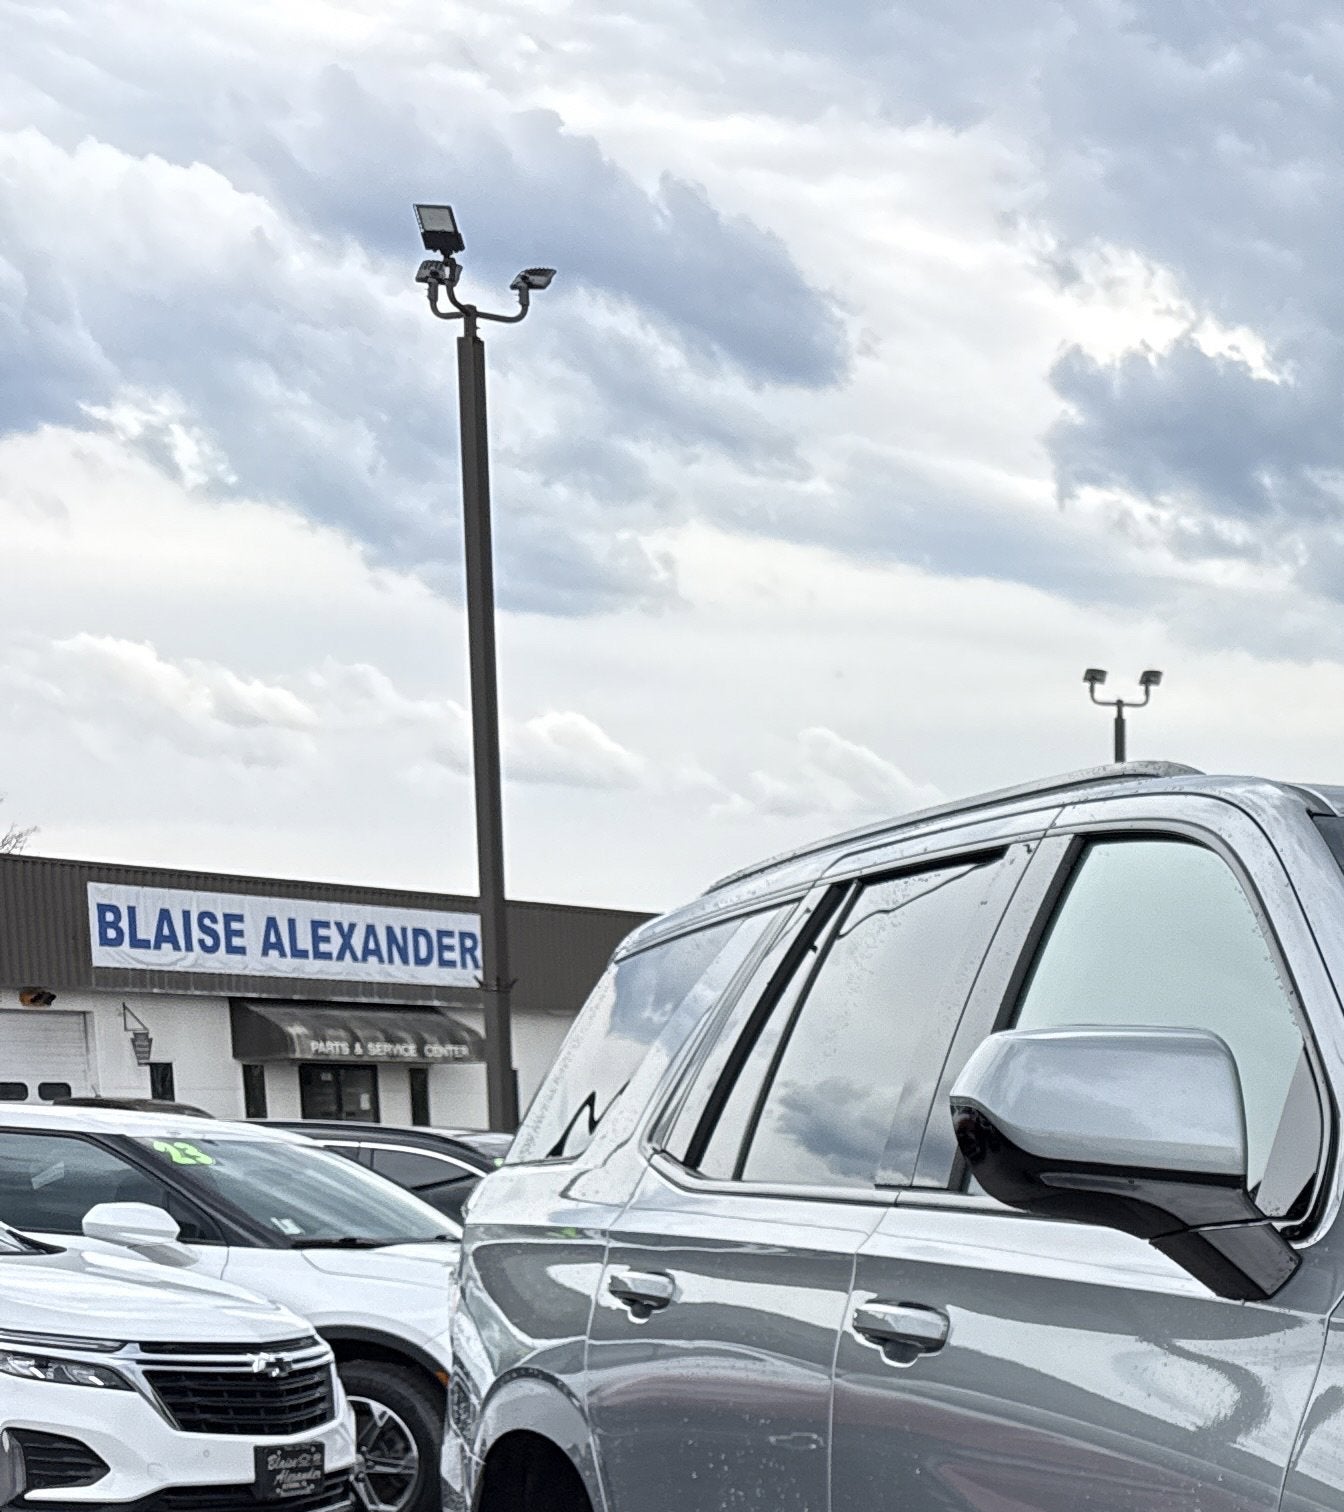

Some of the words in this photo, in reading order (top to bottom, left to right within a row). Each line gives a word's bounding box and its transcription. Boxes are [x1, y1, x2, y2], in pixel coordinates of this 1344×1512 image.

[96, 902, 248, 957] BLAISE
[261, 916, 481, 971] ALEXANDER
[310, 1040, 350, 1056] PARTS
[354, 1041, 364, 1056] &
[367, 1042, 418, 1058] SERVICE
[153, 1140, 217, 1166] 23
